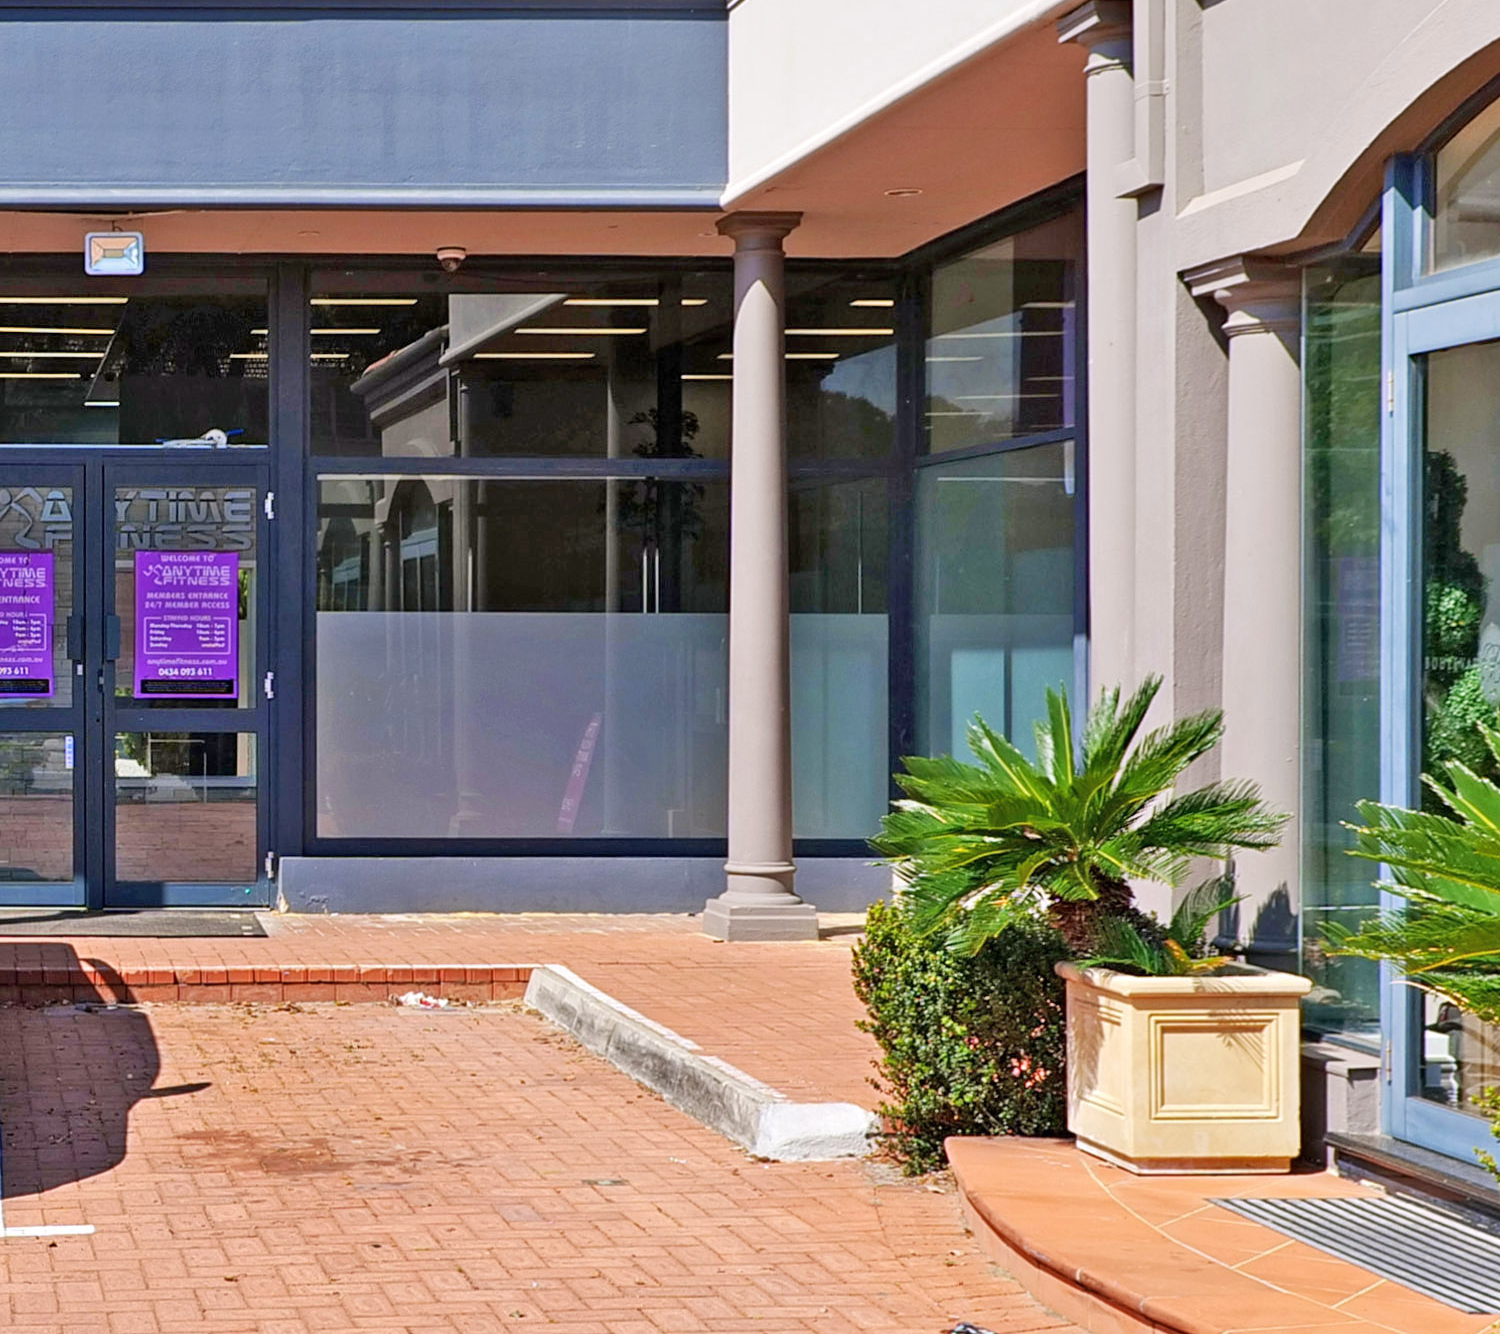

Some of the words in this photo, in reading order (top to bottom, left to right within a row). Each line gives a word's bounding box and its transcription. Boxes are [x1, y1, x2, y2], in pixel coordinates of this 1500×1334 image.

[160, 554, 200, 563] WELCOME
[203, 554, 215, 563] TO
[162, 565, 231, 577] ANYTIME
[163, 576, 231, 586] FITNESS
[14, 667, 30, 676] 611
[158, 667, 179, 676] 0434
[180, 667, 196, 676] 093
[197, 667, 213, 676] 611
